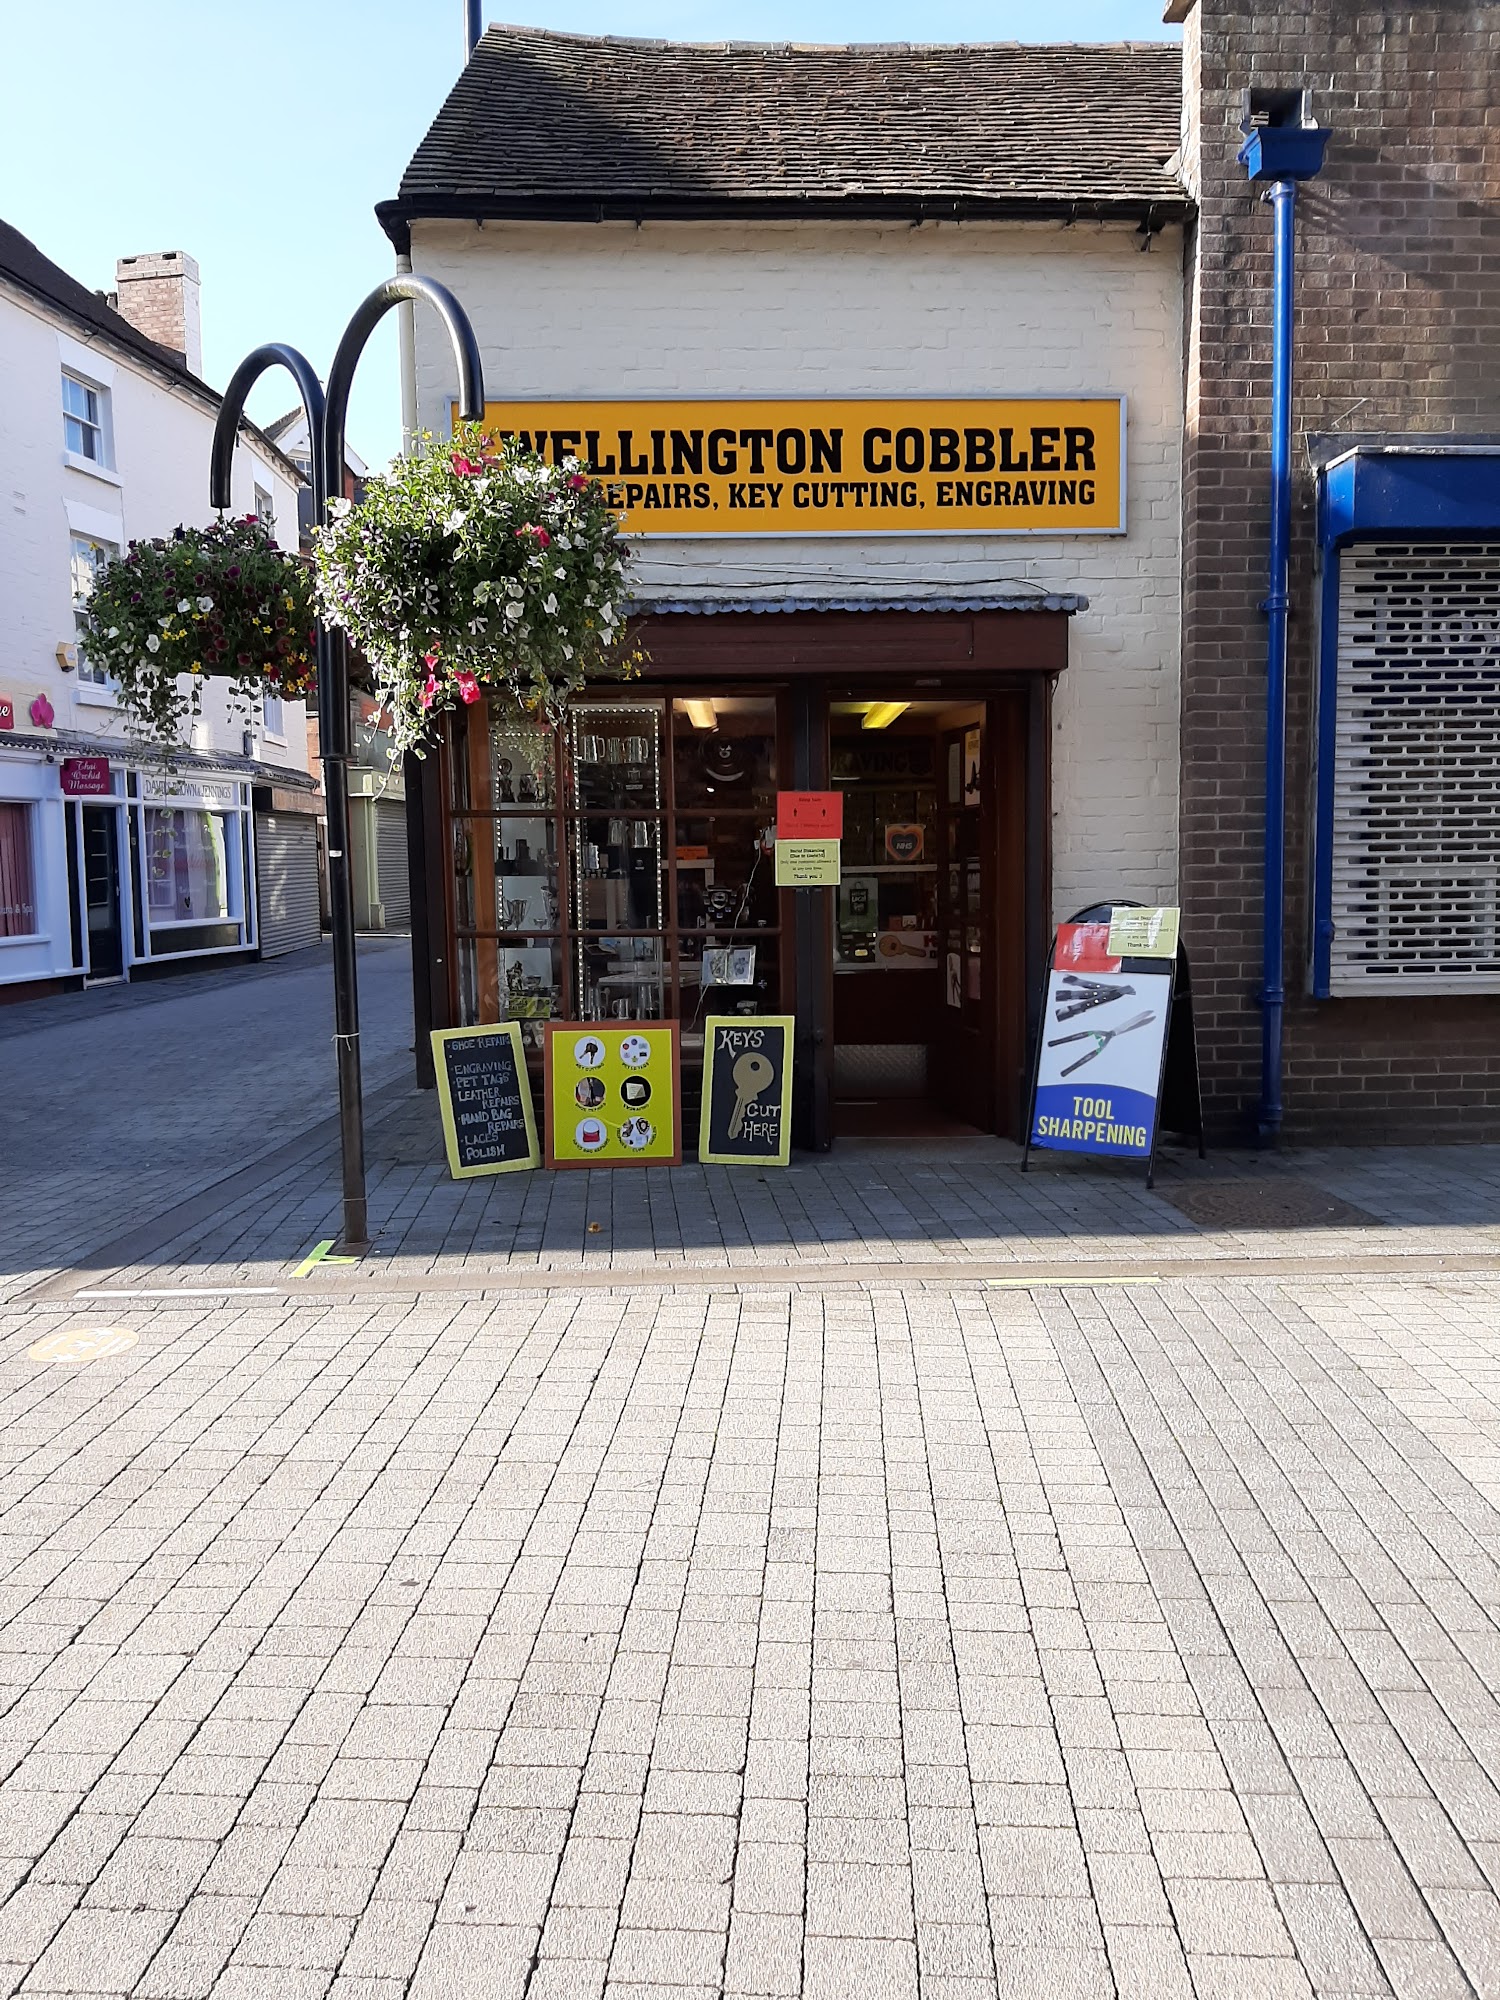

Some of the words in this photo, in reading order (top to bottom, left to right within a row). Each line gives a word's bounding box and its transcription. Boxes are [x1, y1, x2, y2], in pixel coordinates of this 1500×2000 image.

[499, 426, 846, 476] WELLINGTON
[861, 425, 1097, 474] COBBLER
[598, 481, 719, 511] EPAIRS,
[727, 481, 784, 510] KEY
[792, 480, 927, 510] CUTTING,
[934, 479, 1096, 508] ENGRAVING
[76, 760, 97, 771] Thai
[71, 770, 102, 780] Orchid
[68, 779, 105, 792] Massage
[896, 842, 913, 850] NHS
[477, 1034, 511, 1049] REPAIRS
[717, 1029, 766, 1059] KEYS
[454, 1060, 512, 1075] ENGRAVING
[455, 1075, 478, 1089] PET
[481, 1071, 510, 1087] TAGS
[457, 1086, 501, 1102] LEATHER
[481, 1094, 520, 1110] REPAIRS
[746, 1102, 781, 1117] CUT
[1072, 1095, 1115, 1121] TOOL
[460, 1110, 489, 1126] HAND
[490, 1108, 513, 1121] BAG
[487, 1118, 525, 1135] REPAIRS
[742, 1120, 779, 1146] HERE
[1037, 1114, 1147, 1149] SHARPENING
[464, 1131, 500, 1146] LACES
[465, 1143, 506, 1161] POLISH
